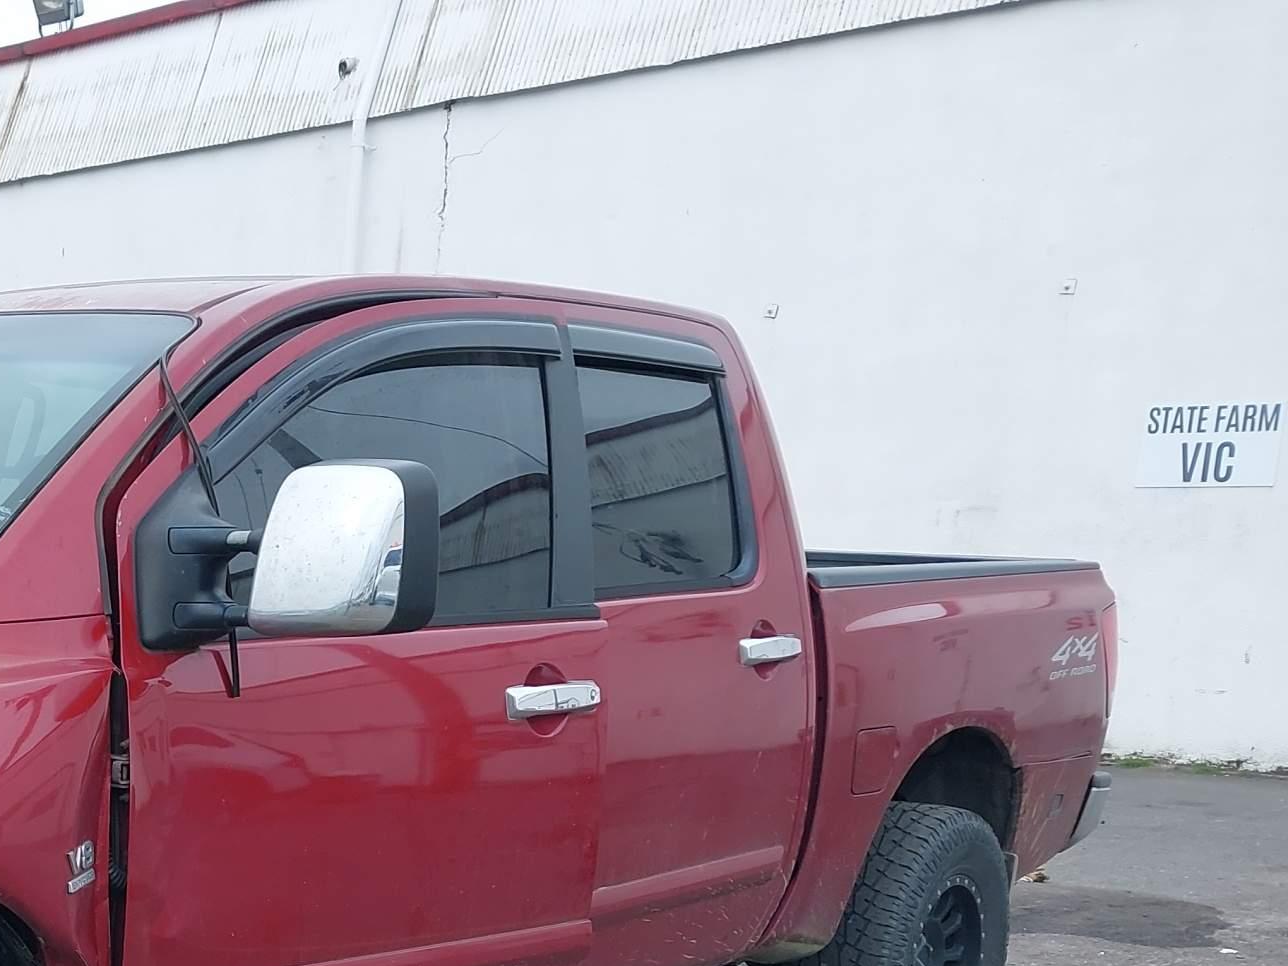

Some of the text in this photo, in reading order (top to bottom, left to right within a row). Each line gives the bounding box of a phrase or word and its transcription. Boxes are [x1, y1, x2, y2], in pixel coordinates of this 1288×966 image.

[1147, 402, 1282, 434] STATE FARM
[1181, 441, 1236, 483] VIC
[66, 840, 94, 875] V8
